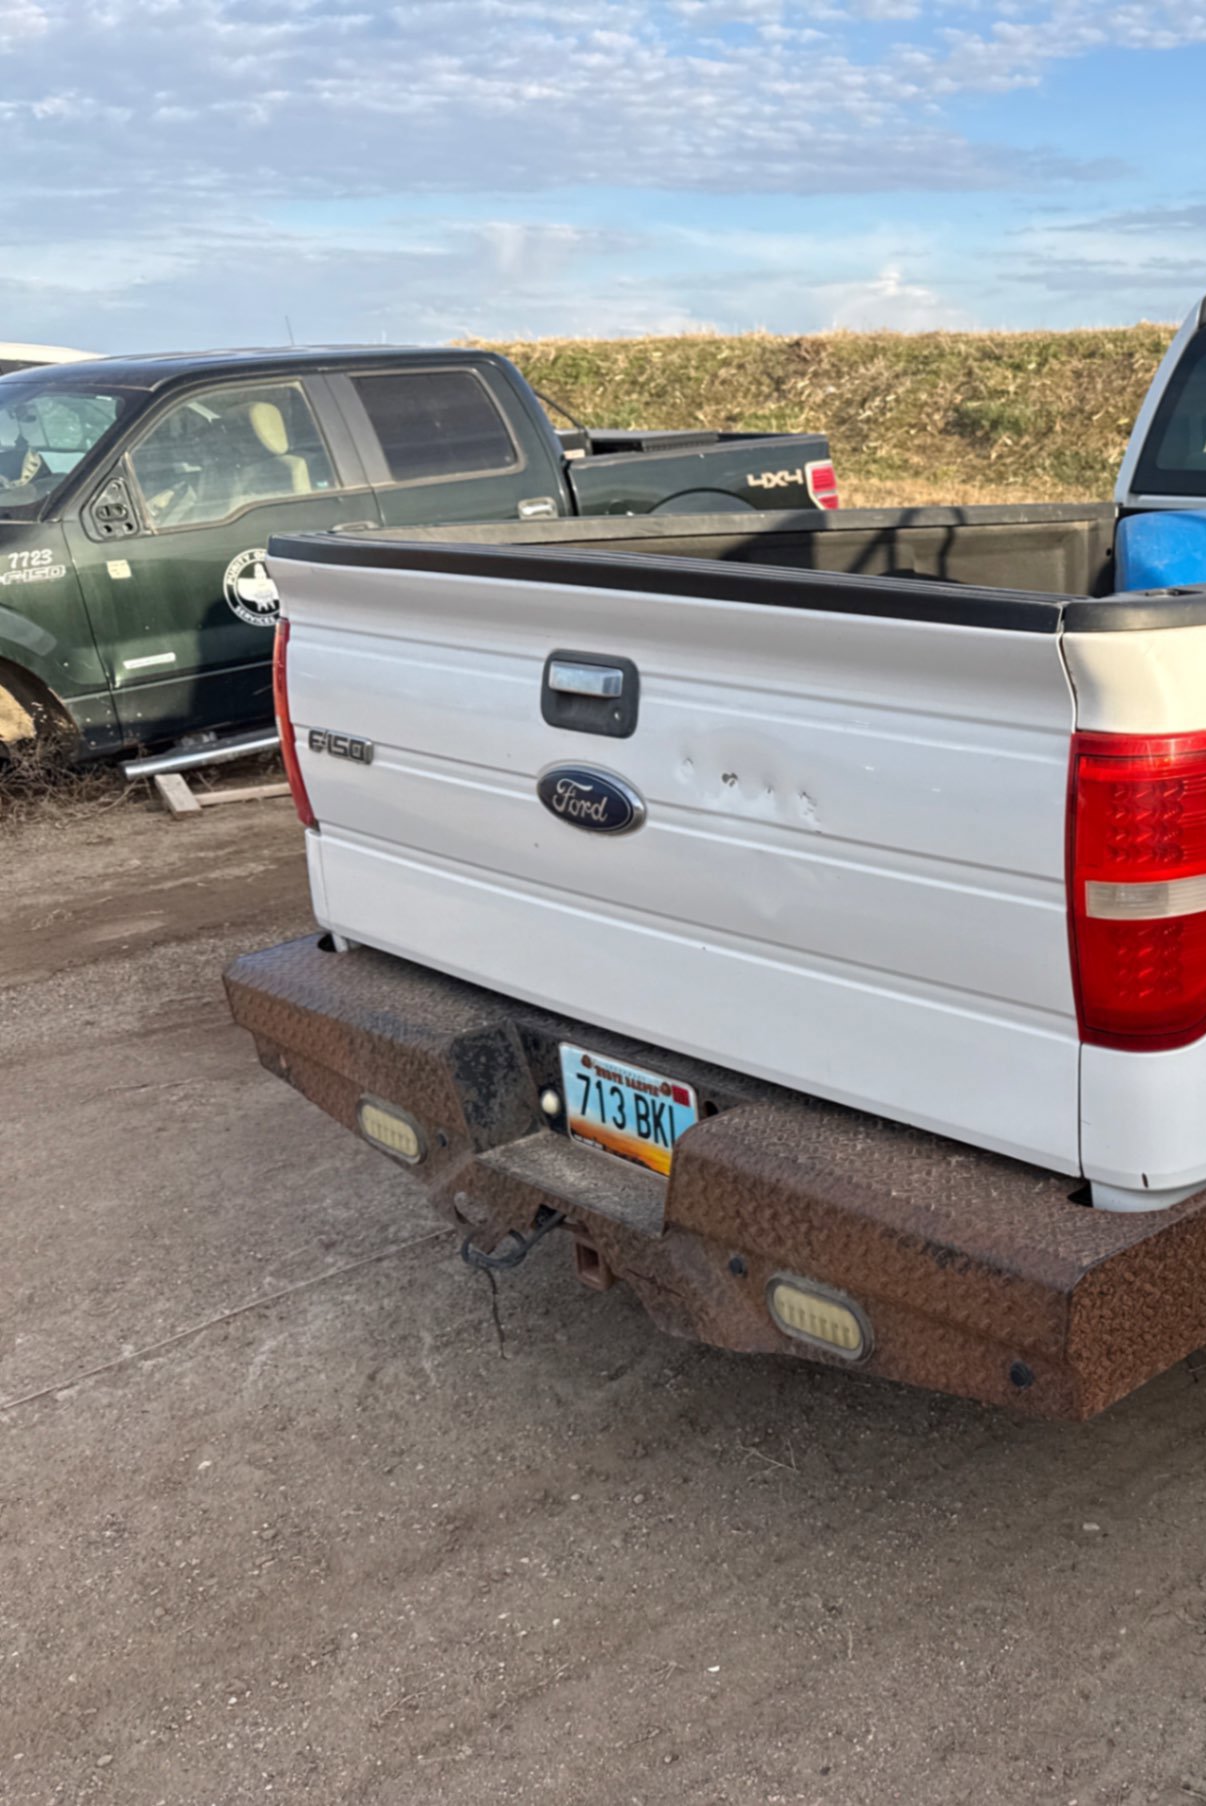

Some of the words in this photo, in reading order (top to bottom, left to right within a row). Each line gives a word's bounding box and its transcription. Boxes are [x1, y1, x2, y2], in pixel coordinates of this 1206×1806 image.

[8, 549, 53, 568] 7723
[552, 778, 608, 821] Ford
[576, 1072, 626, 1130] 713
